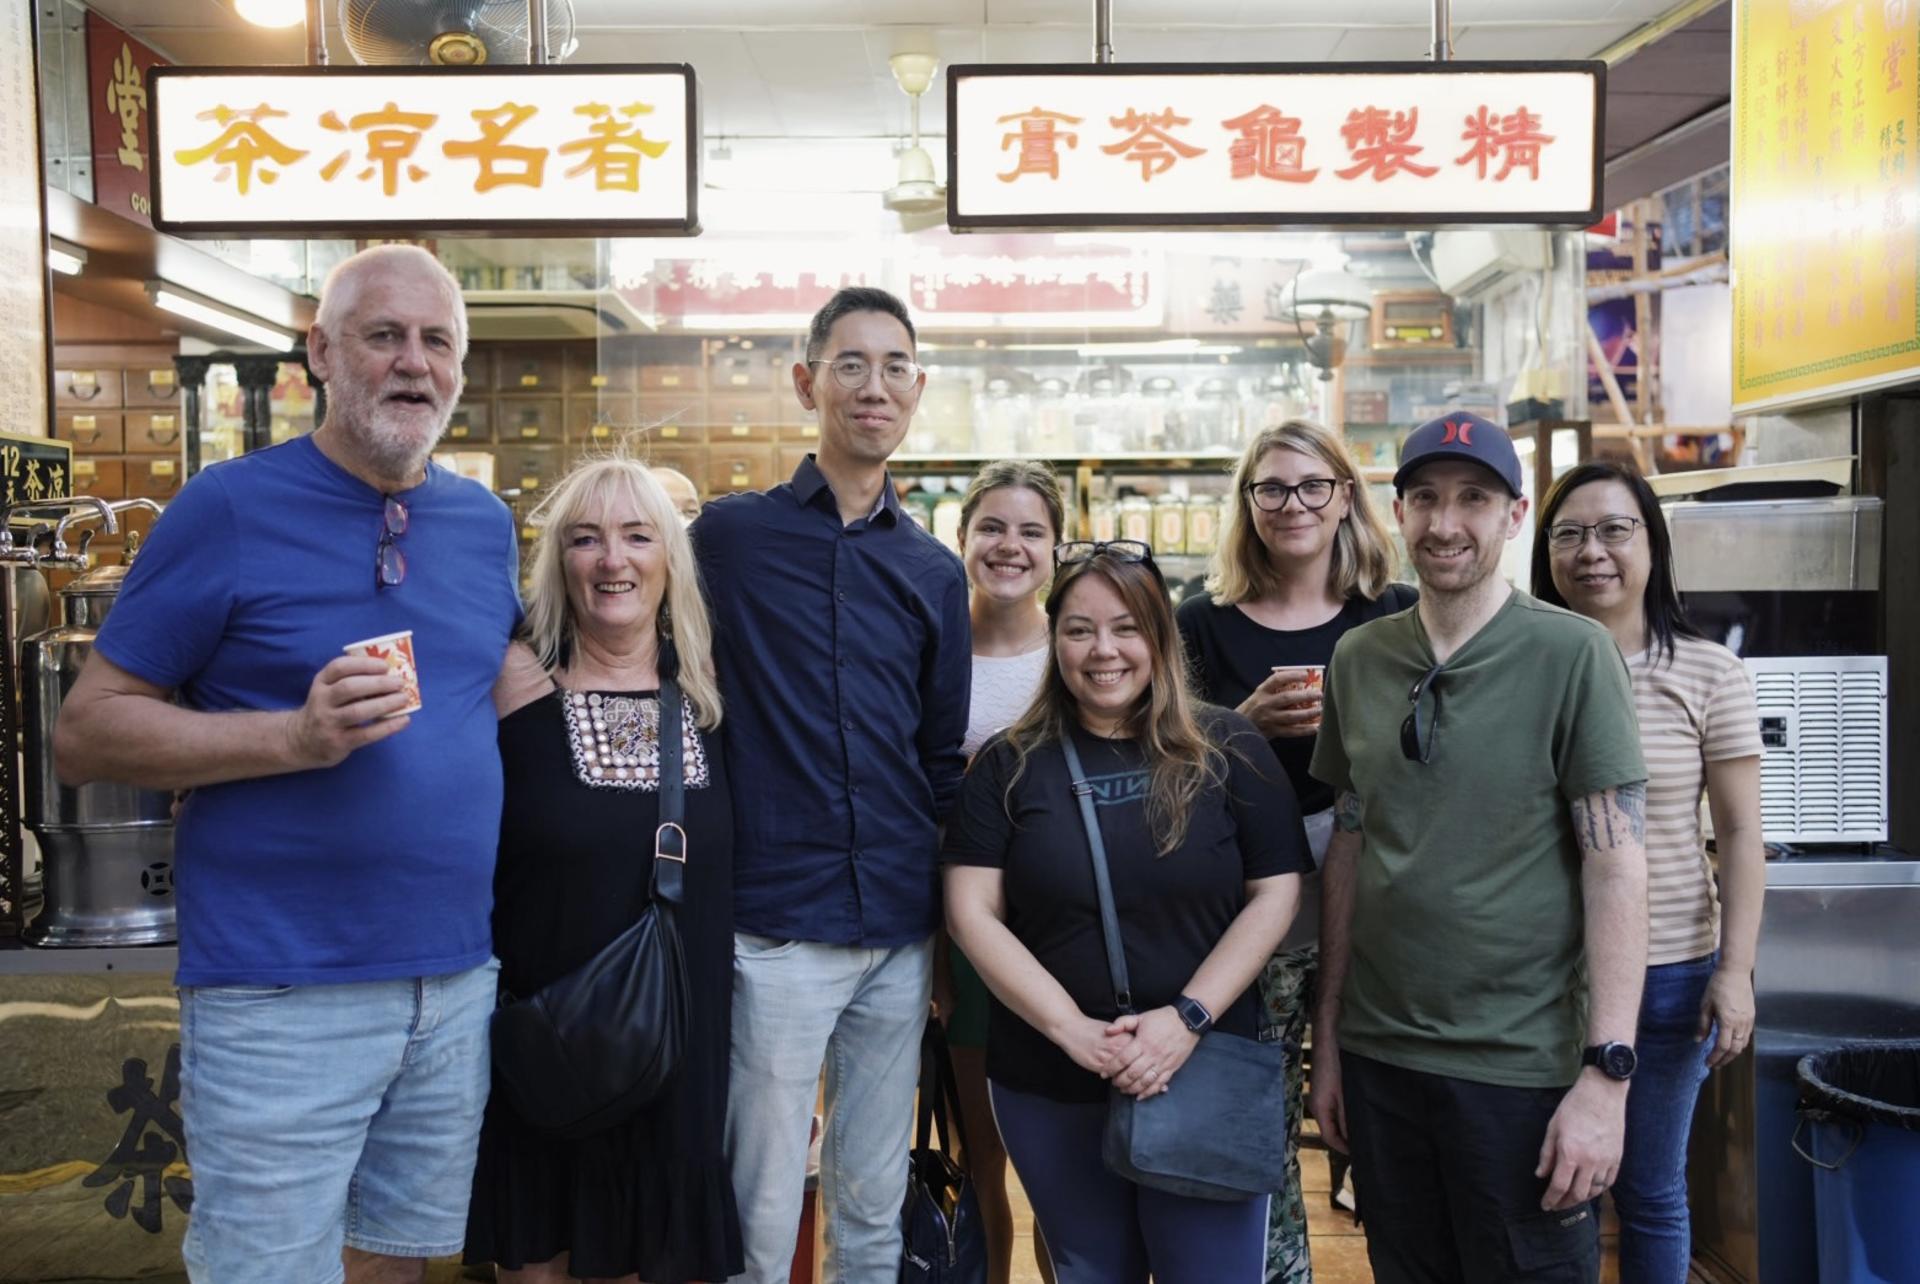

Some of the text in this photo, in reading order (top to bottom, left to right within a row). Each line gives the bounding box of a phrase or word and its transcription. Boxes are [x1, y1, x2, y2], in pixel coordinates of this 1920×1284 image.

[107, 43, 148, 171] 堂
[996, 104, 1557, 183] 精製龜苓膏
[1, 445, 20, 477] 12
